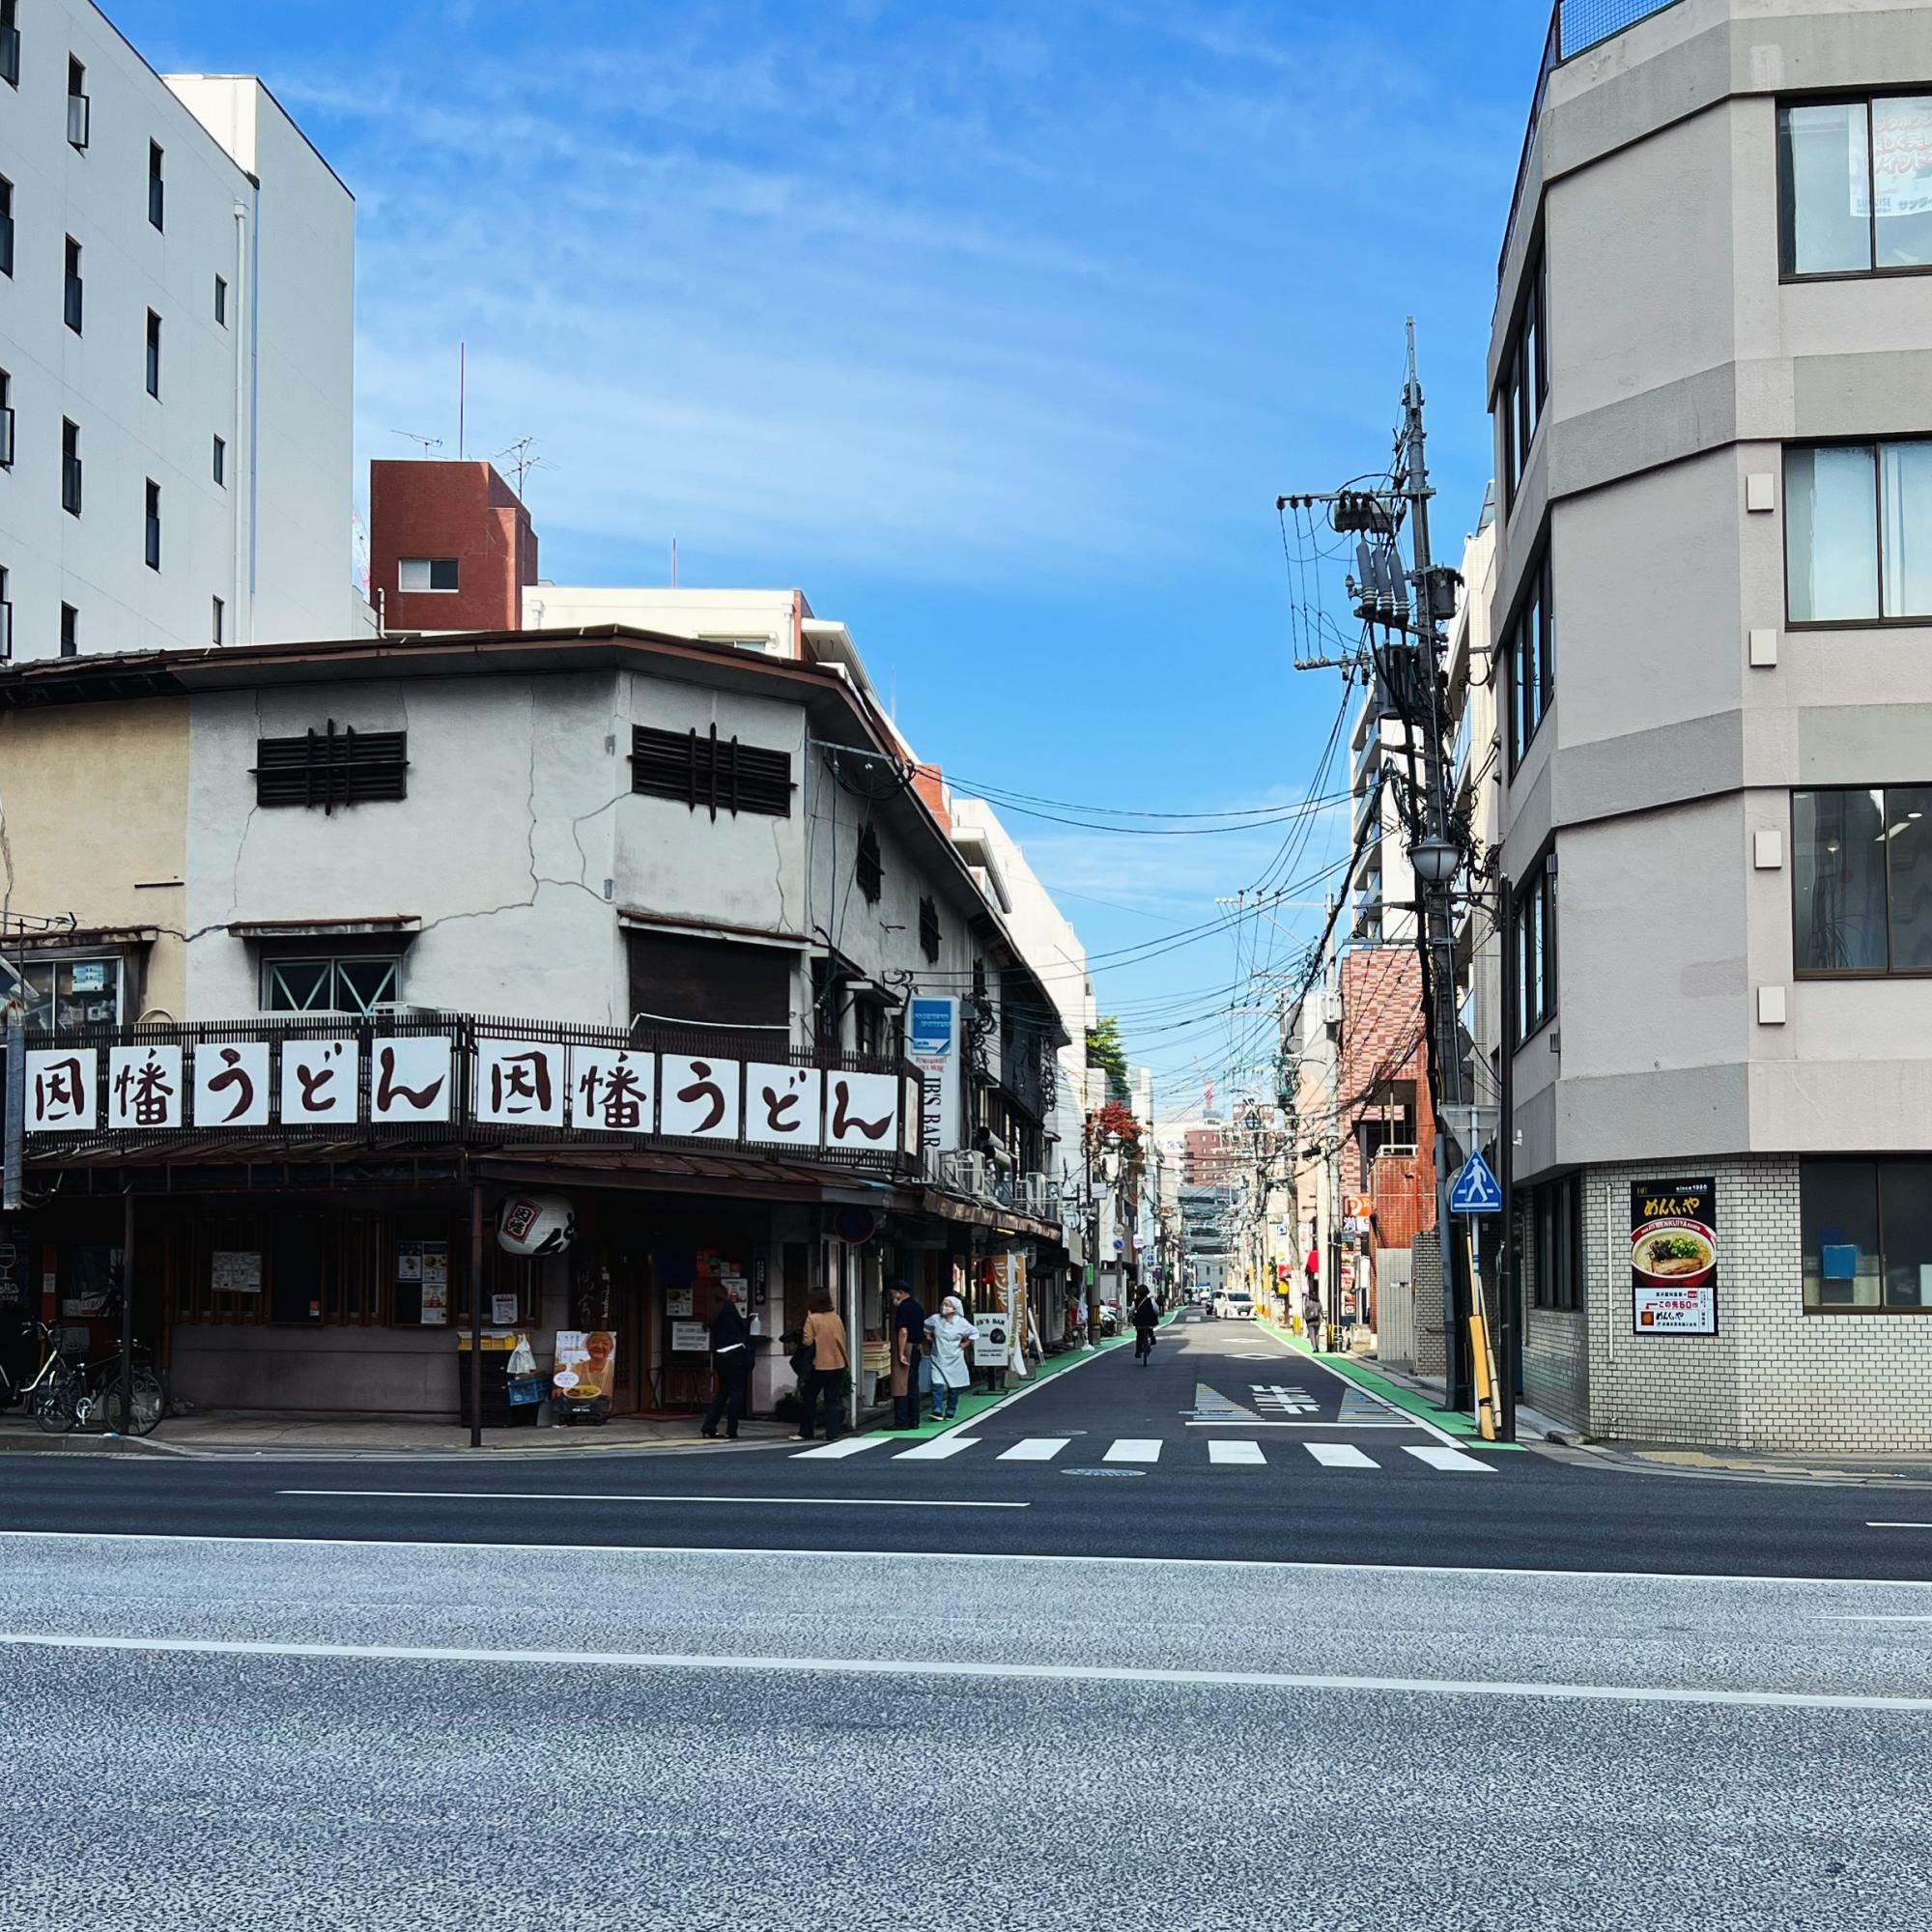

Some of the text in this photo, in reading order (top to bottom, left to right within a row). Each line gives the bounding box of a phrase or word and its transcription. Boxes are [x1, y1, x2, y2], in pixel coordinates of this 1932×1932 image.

[36, 1042, 445, 1125] 因幡うどん
[491, 1050, 895, 1140] 因幡うどん
[923, 1113, 941, 1147] BAR
